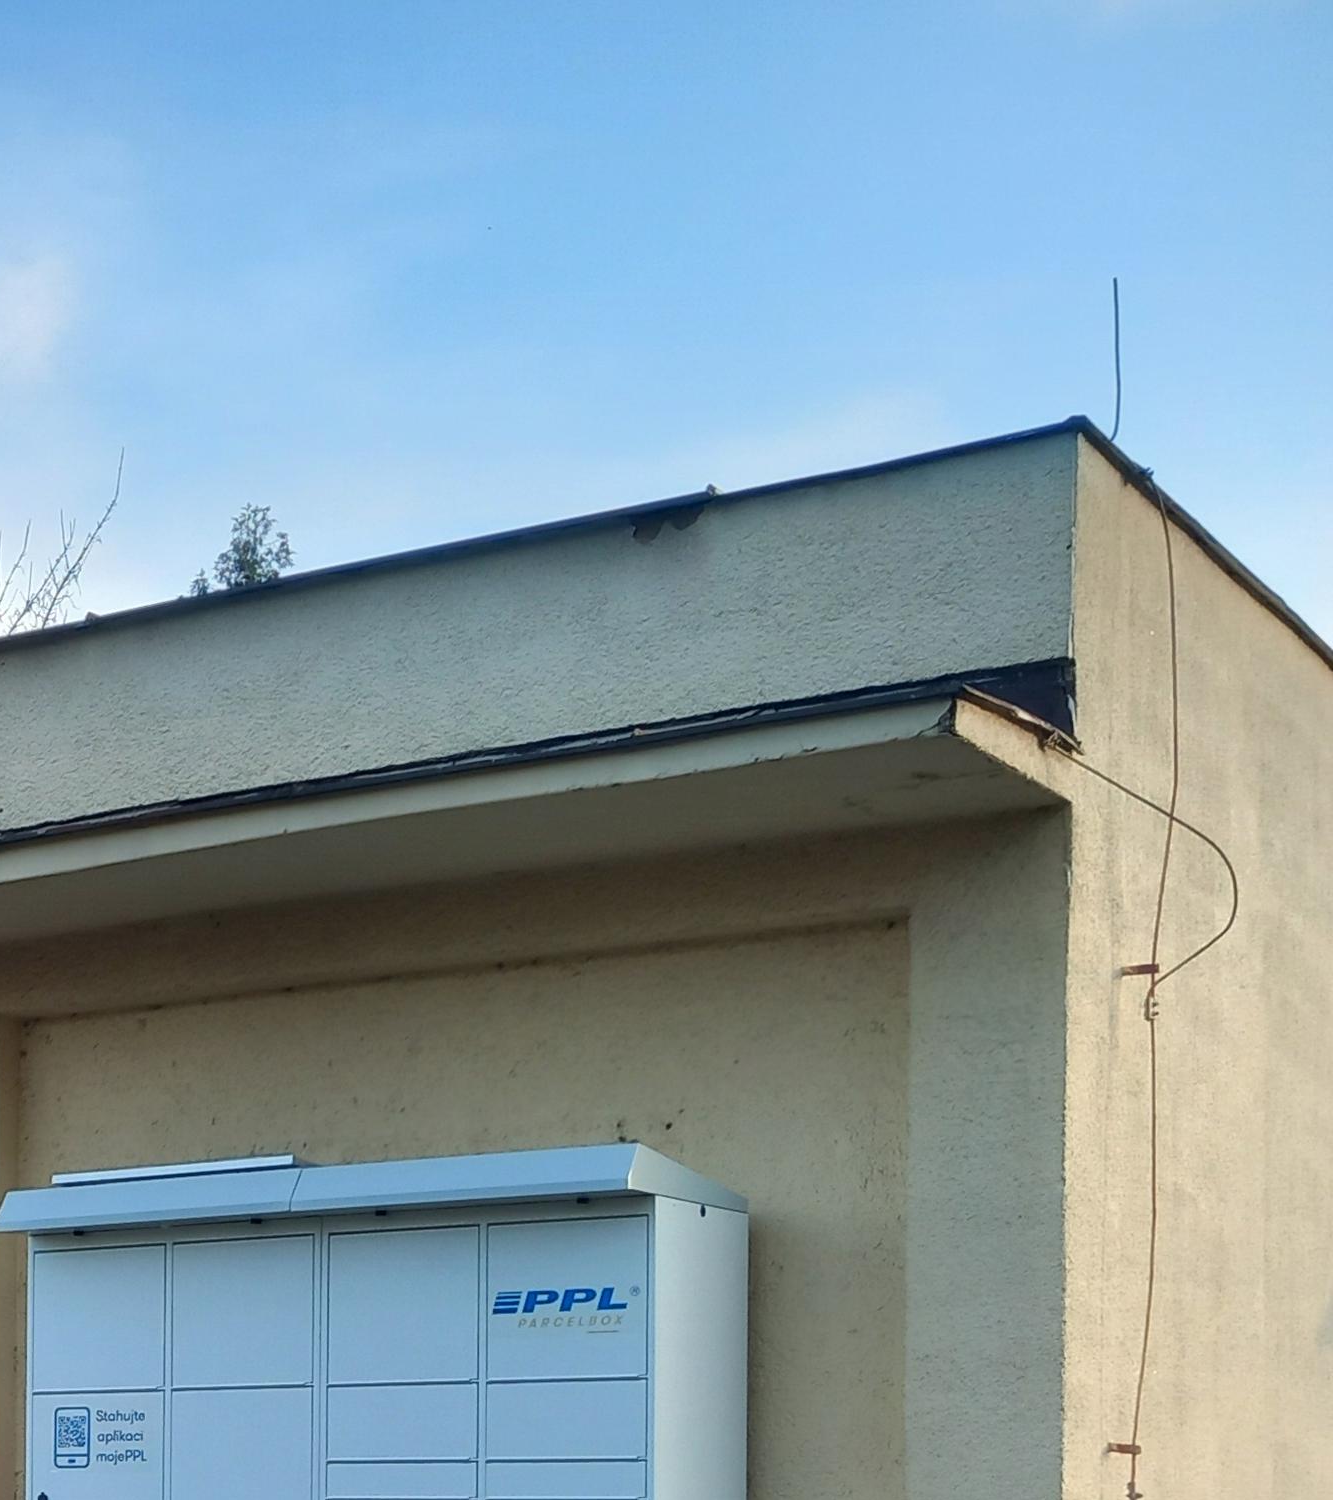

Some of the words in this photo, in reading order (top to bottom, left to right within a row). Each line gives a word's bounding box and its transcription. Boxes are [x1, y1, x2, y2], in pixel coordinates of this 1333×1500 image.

[521, 1286, 629, 1314] PPL
[517, 1315, 625, 1329] PARCELBOX
[95, 1409, 146, 1425] Stahujte
[96, 1430, 144, 1445] aplikaci
[95, 1449, 147, 1466] mojePPL
